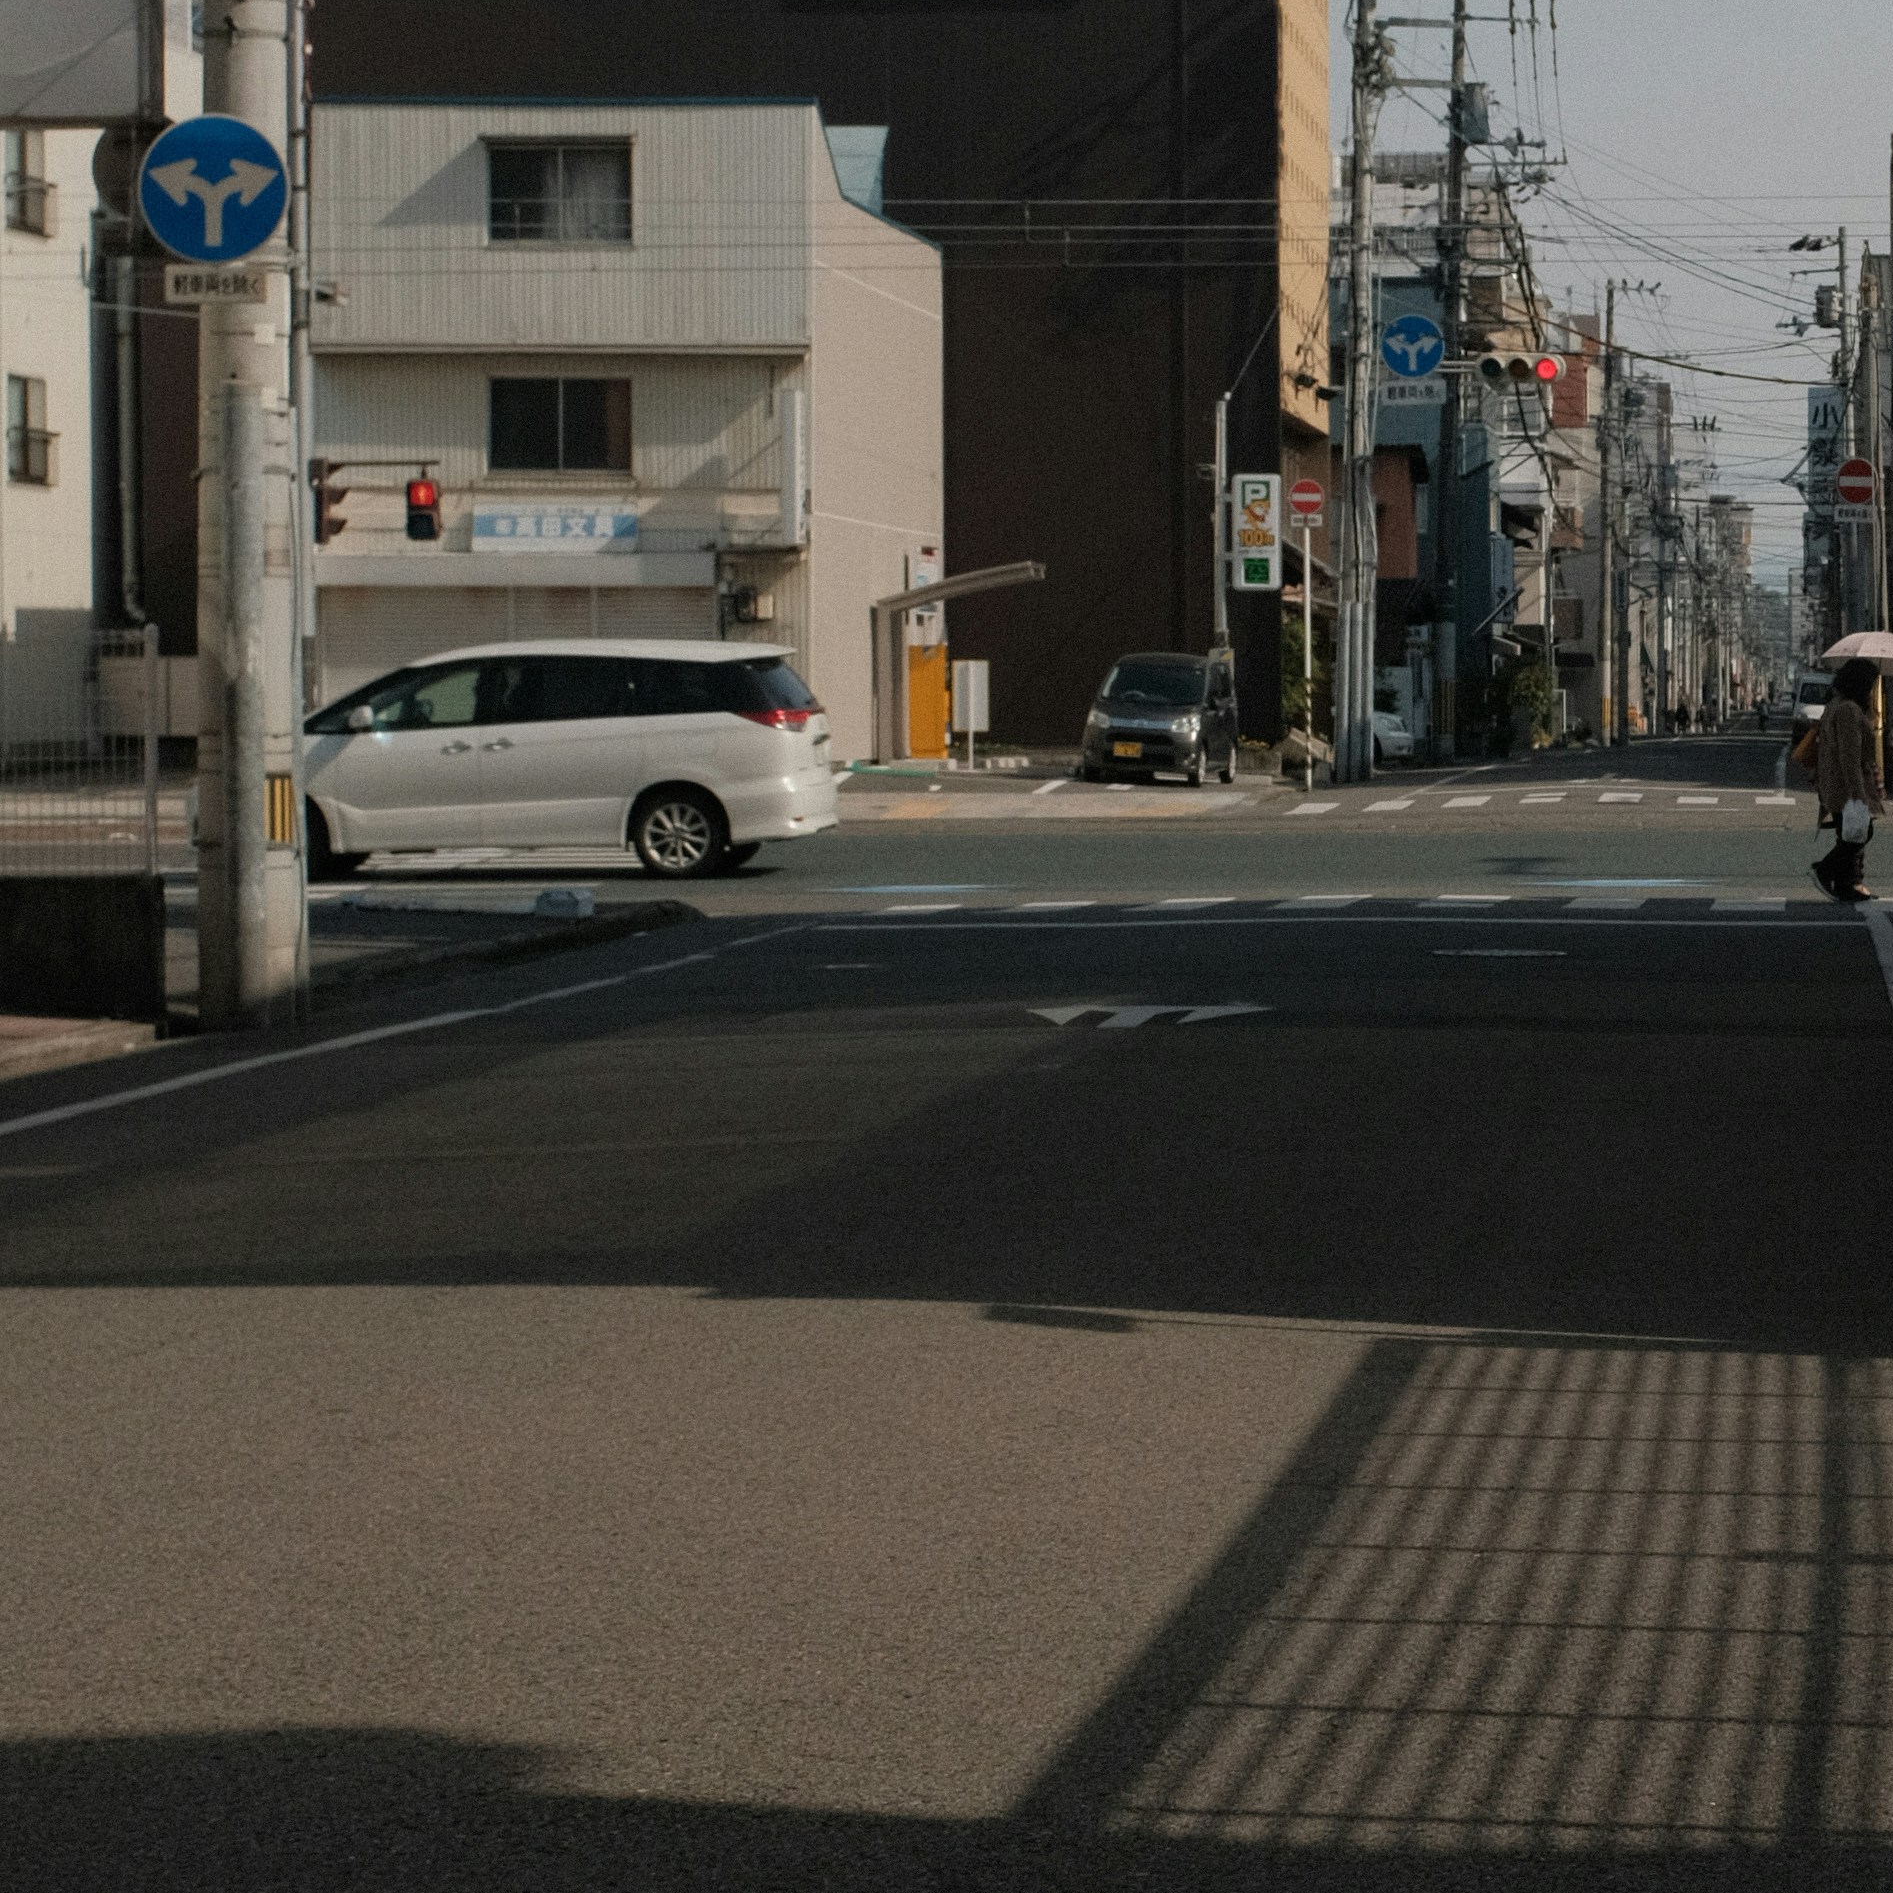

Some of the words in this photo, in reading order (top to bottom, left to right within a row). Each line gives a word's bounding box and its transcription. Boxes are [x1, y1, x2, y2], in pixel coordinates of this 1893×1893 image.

[174, 274, 259, 295] 軽車両を除く
